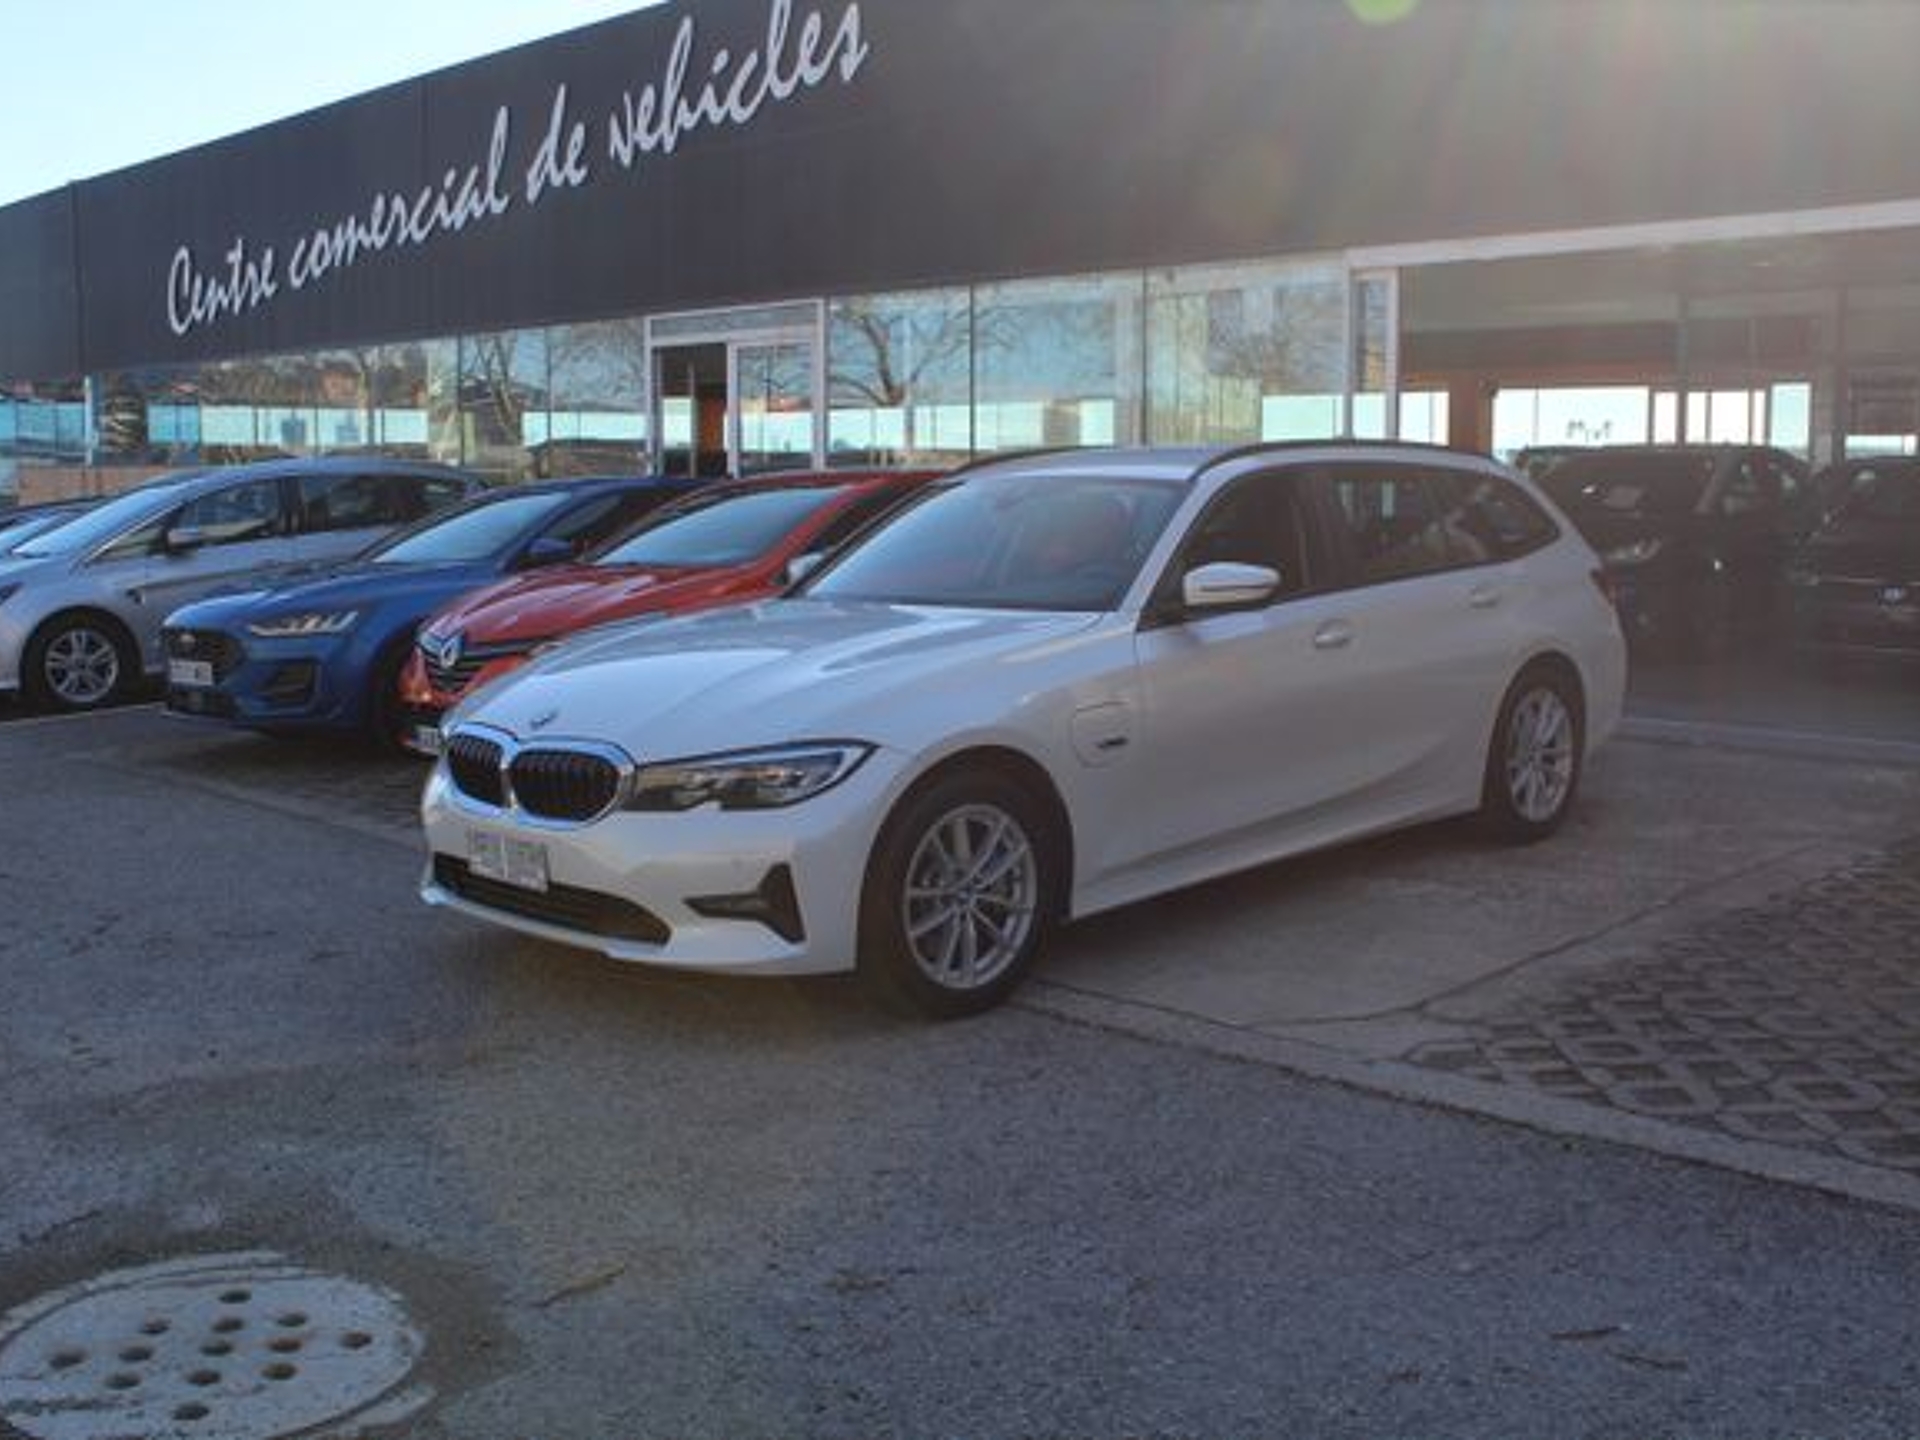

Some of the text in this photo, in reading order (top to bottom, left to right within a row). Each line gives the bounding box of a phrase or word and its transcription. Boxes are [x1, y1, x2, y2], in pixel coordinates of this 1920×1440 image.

[167, 0, 869, 336] Centre comercial de vehicles
